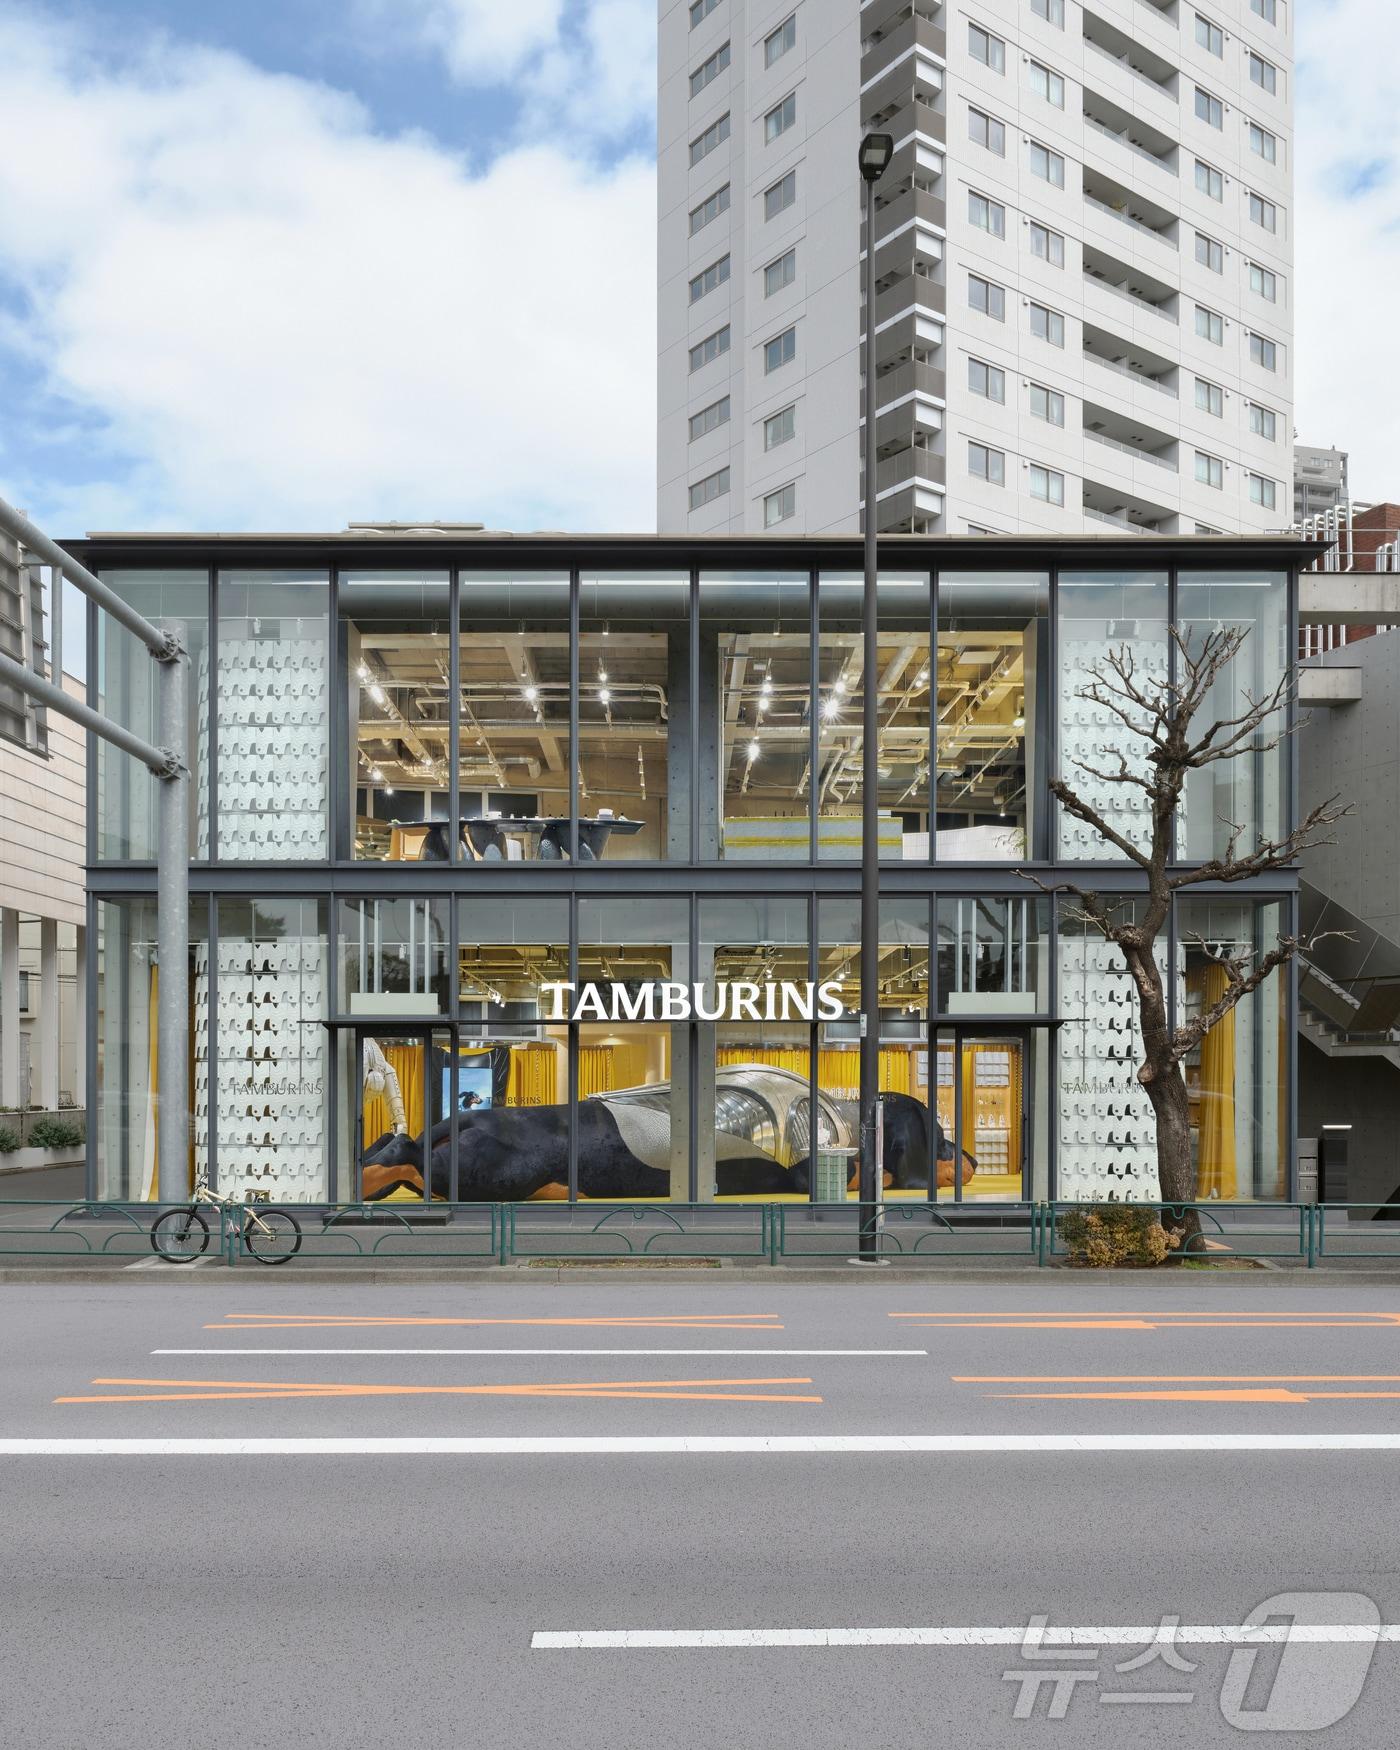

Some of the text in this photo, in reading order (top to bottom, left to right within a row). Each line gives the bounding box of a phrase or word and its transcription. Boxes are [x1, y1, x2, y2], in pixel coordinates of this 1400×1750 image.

[541, 981, 843, 1020] TAMBURINS
[229, 1083, 323, 1095] TAMBURINS
[1063, 1082, 1147, 1094] TAMBURIN
